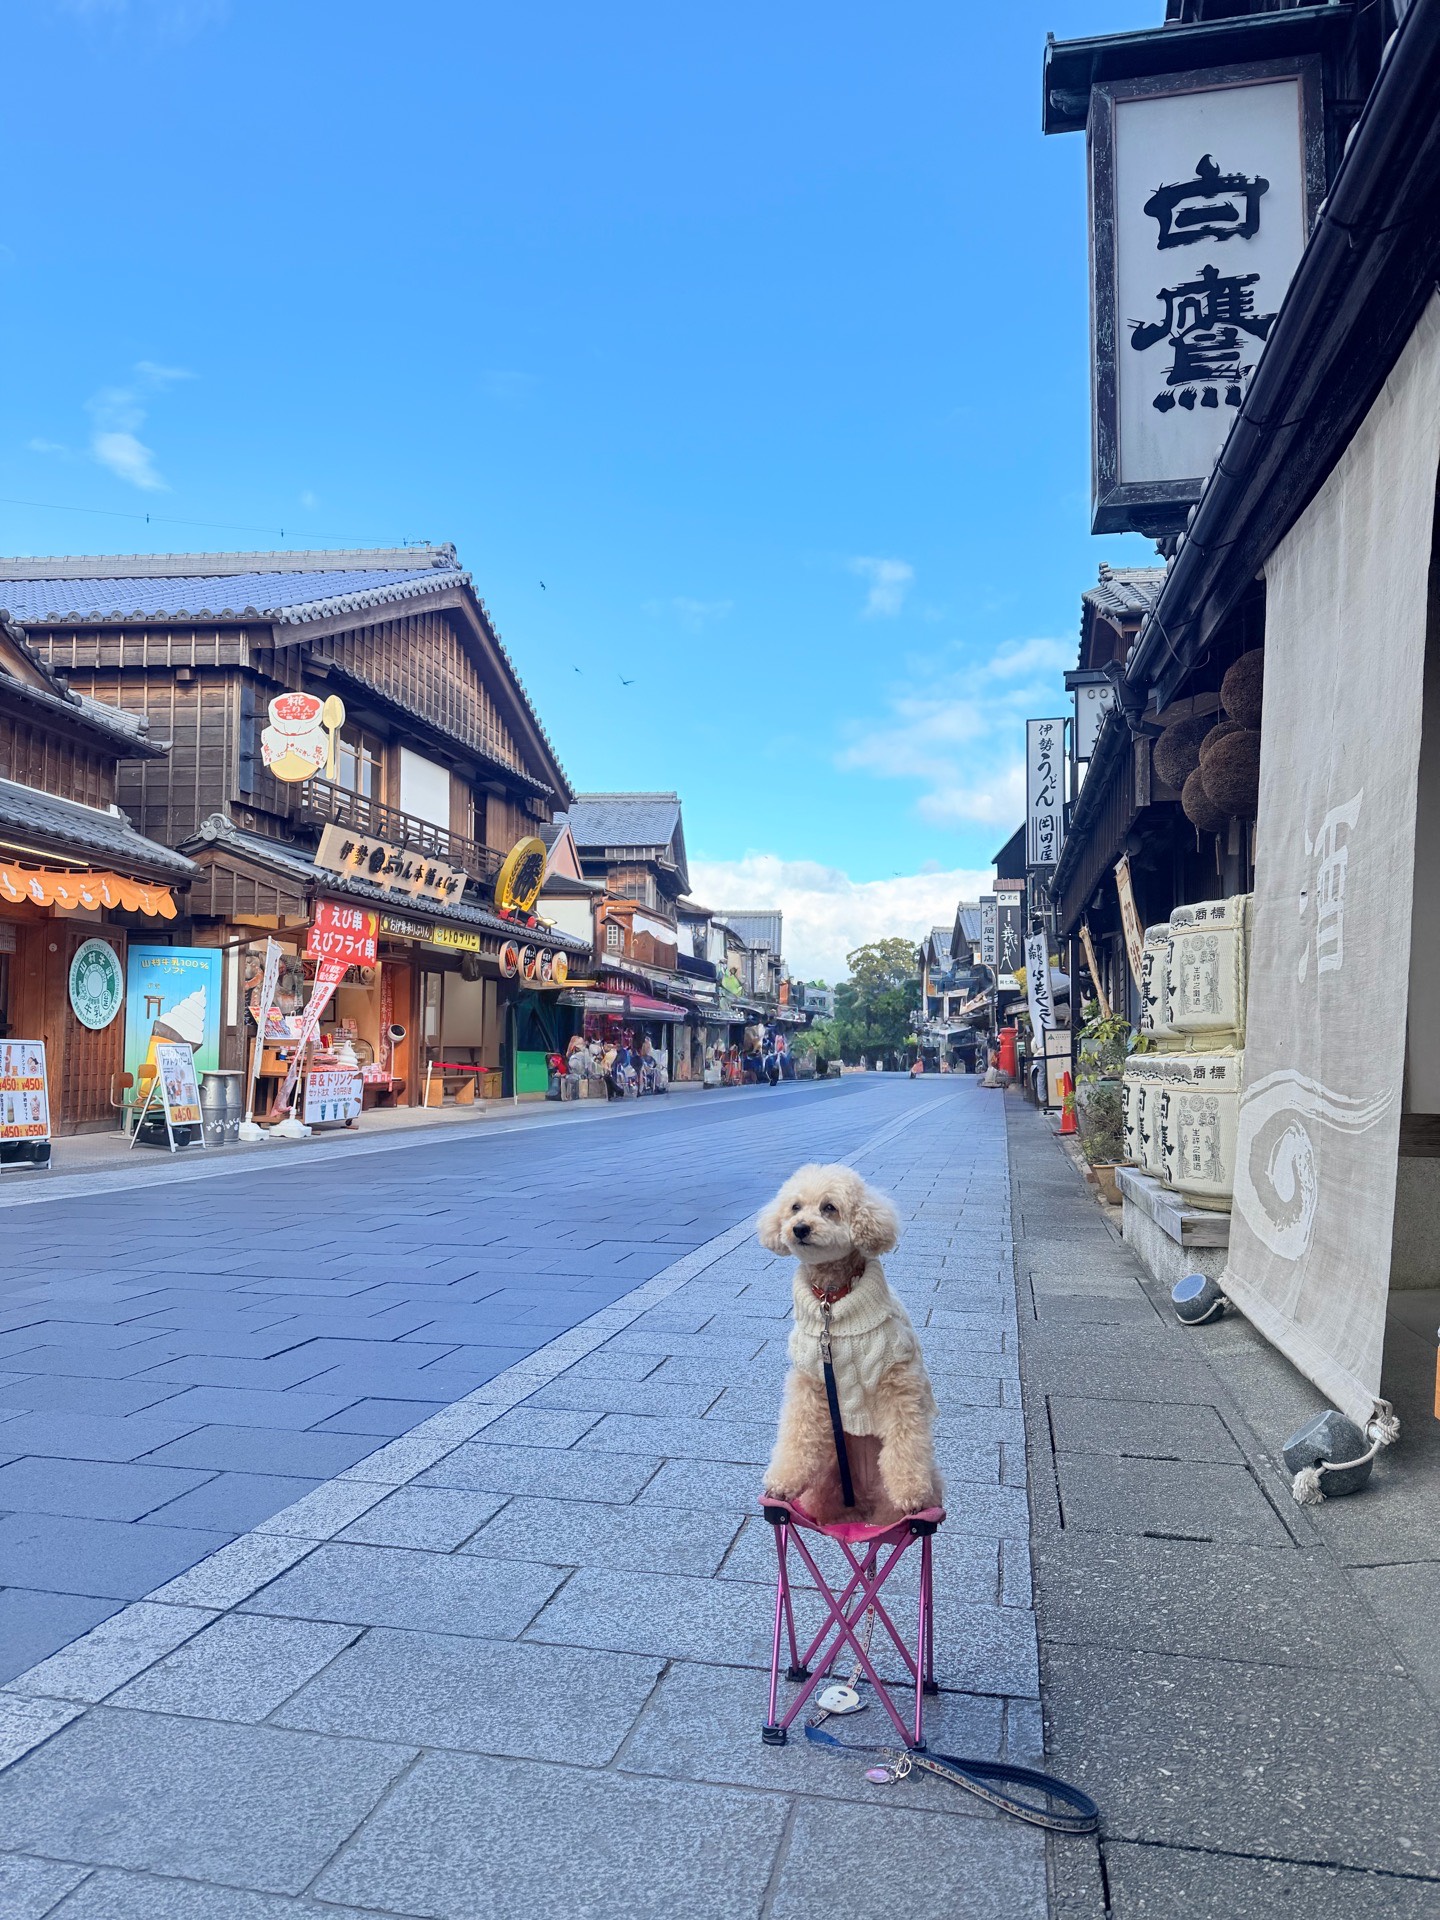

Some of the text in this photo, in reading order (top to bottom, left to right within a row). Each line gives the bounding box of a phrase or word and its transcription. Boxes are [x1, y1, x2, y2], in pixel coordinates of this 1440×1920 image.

[1127, 153, 1280, 414] 白鷹
[279, 705, 314, 714] ぷりん
[1038, 814, 1055, 861] 岡田屋
[1298, 787, 1364, 984] 酒
[331, 905, 363, 932] えび串
[1194, 906, 1226, 921] 商標
[311, 928, 376, 959] えびフライ串
[984, 926, 995, 962] 岡七酒店
[1193, 1065, 1226, 1079] 商標
[24, 1124, 44, 1137] ¥550
